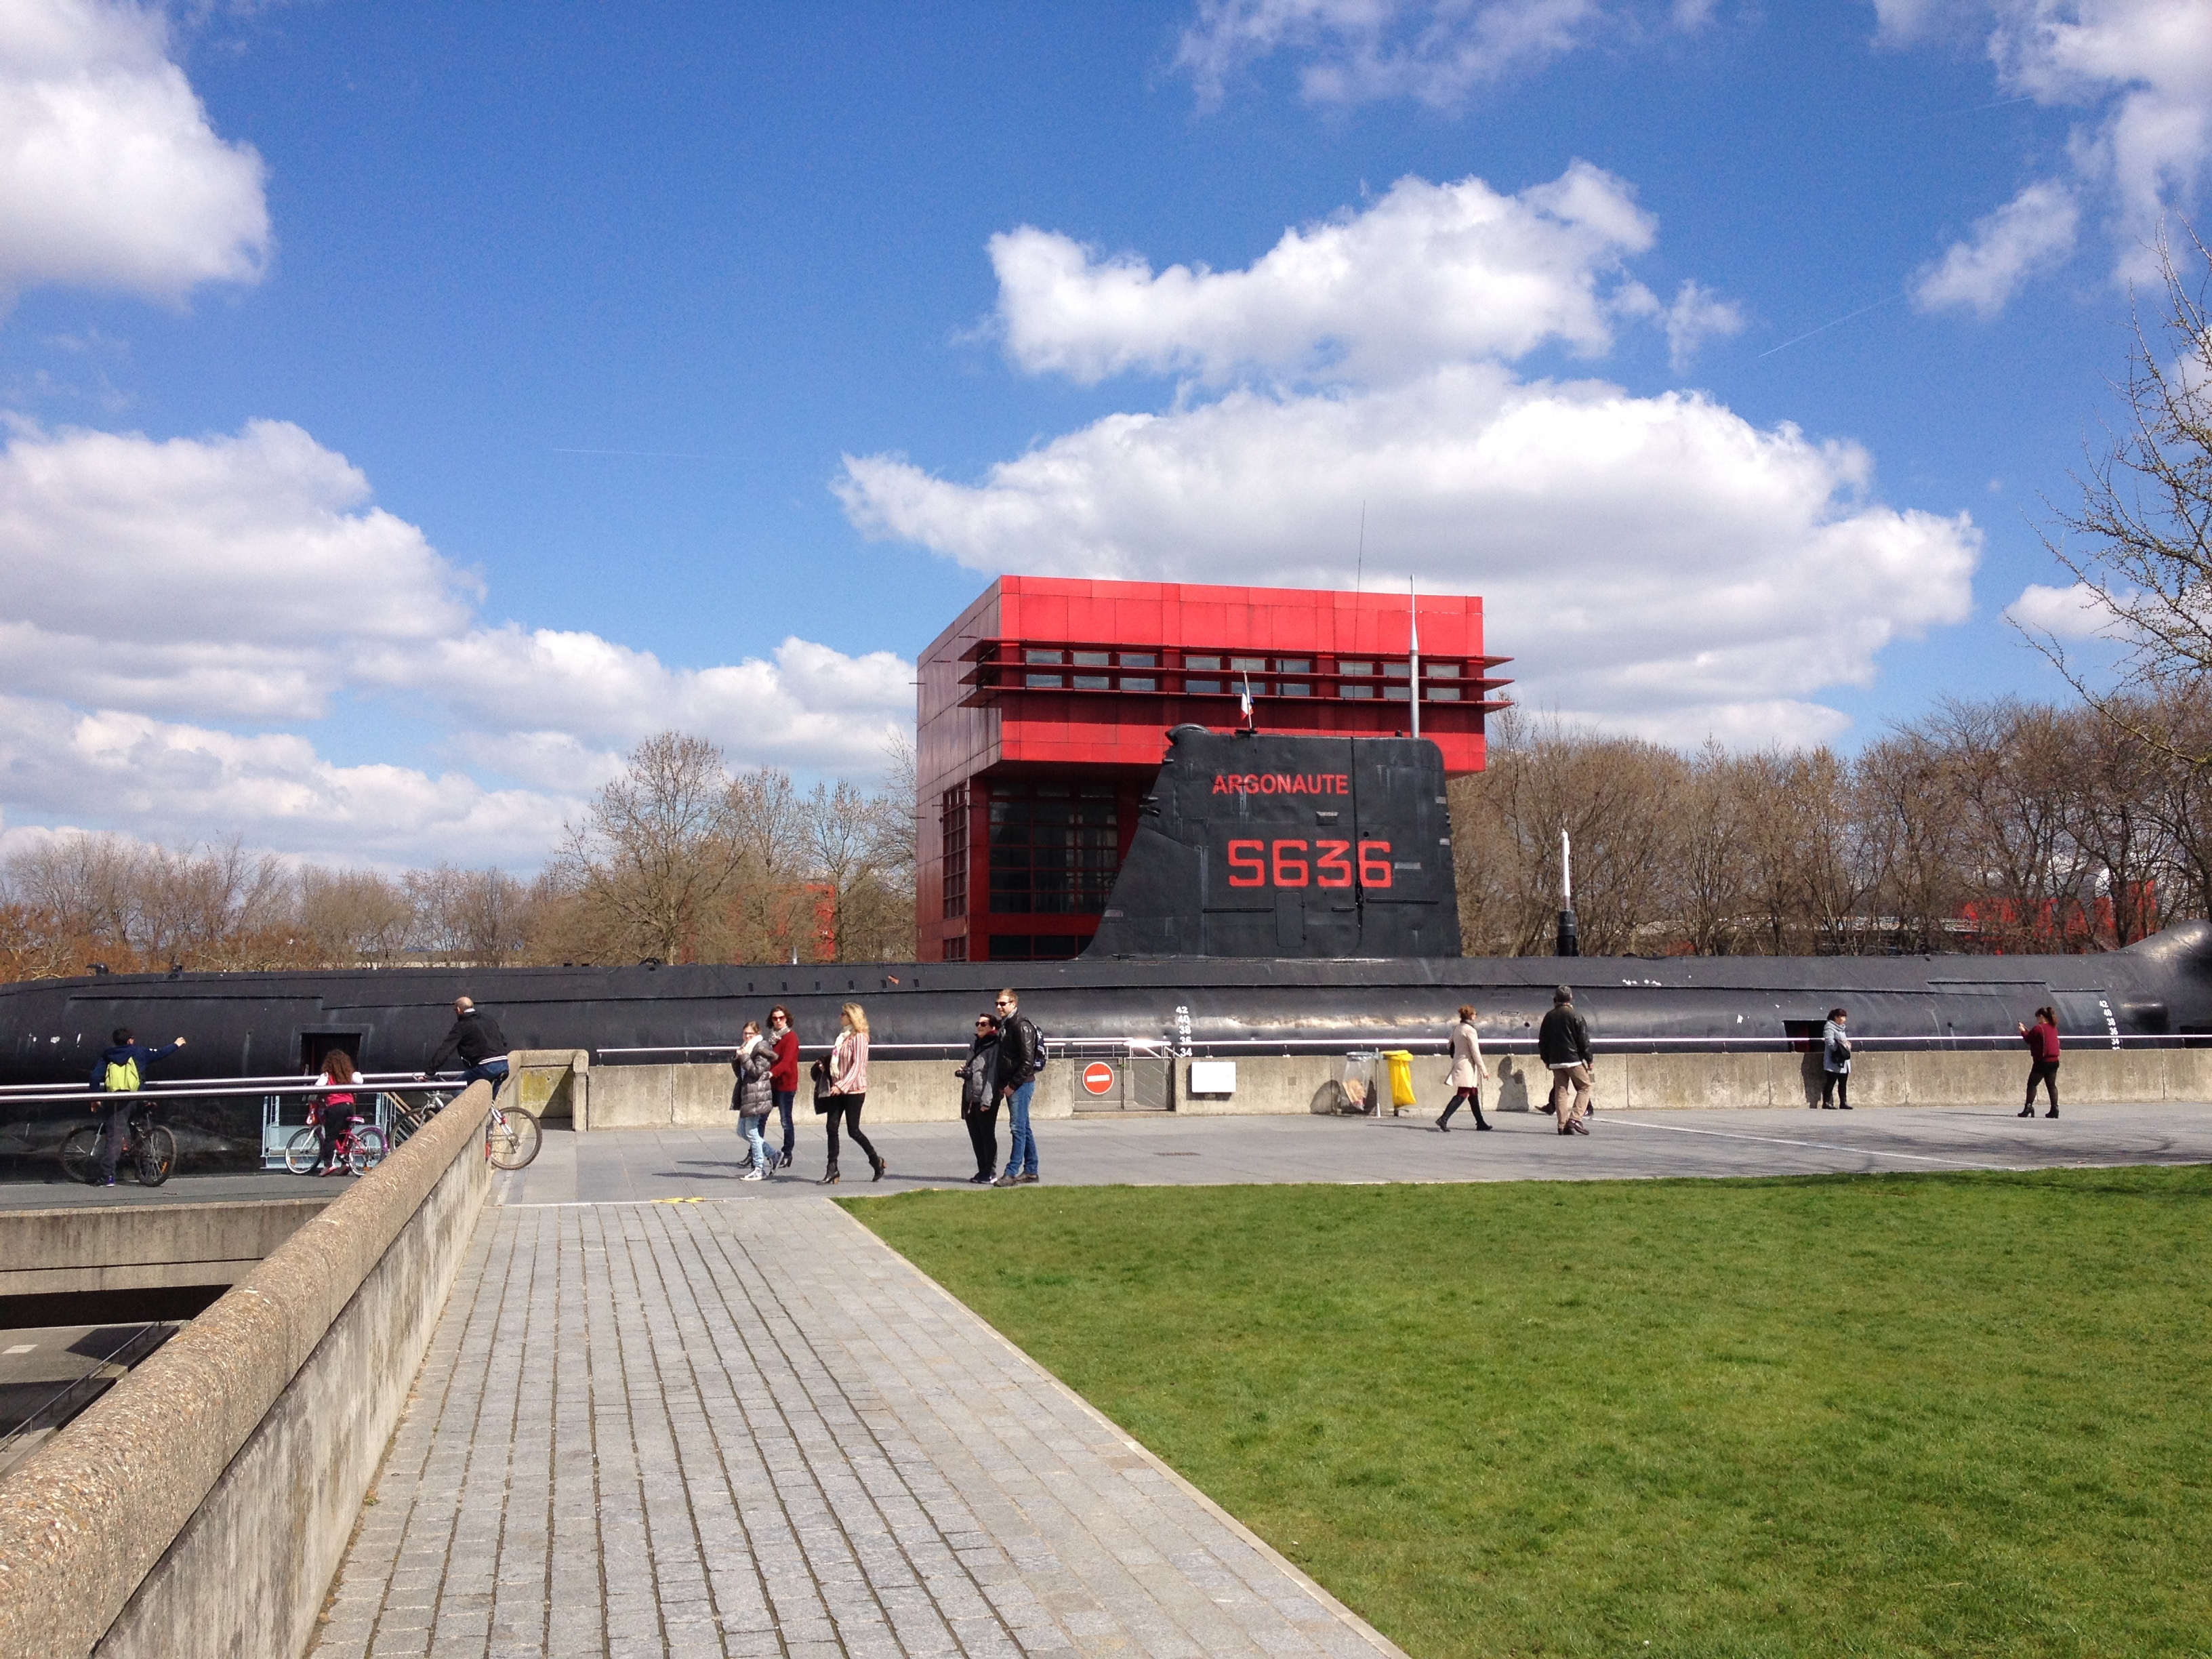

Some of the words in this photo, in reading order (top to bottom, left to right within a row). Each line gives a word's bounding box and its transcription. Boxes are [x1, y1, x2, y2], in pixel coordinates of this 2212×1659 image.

[1212, 773, 1349, 794] ARGONAUTE
[1227, 839, 1393, 888] S636
[1176, 1006, 1189, 1014] 42
[2104, 1008, 2112, 1017] 40
[1177, 1015, 1190, 1023] 40
[2106, 1017, 2116, 1026] 38
[1179, 1025, 1191, 1034] 38
[2109, 1027, 2118, 1036] 36
[1180, 1047, 1193, 1057] 34
